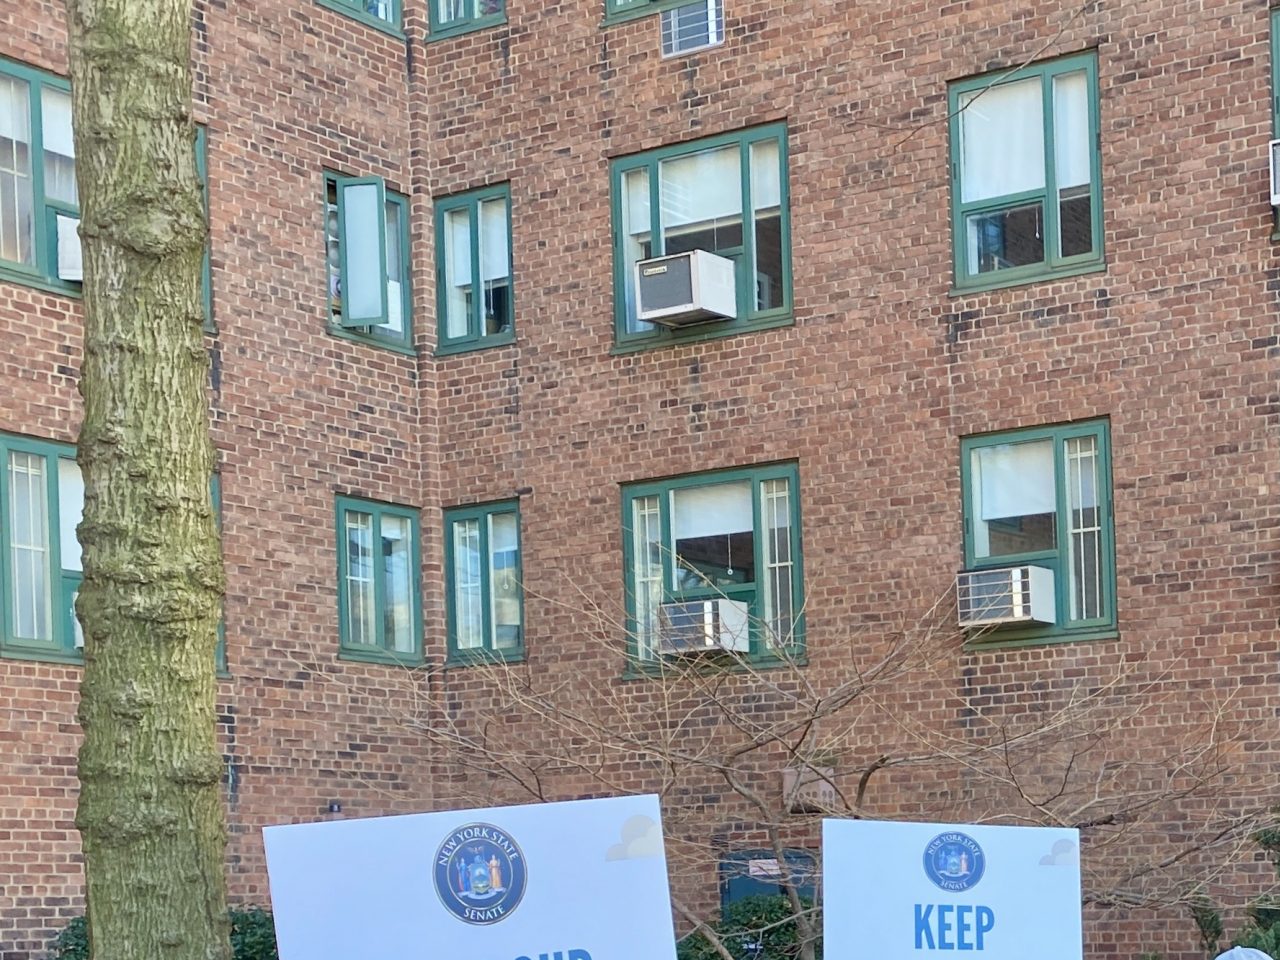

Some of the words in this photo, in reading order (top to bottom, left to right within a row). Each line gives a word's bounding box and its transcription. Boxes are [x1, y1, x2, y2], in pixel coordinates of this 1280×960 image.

[438, 837, 458, 866] NEW
[456, 827, 490, 842] YORK
[491, 831, 520, 861] STATE
[463, 904, 506, 921] SENATE
[914, 904, 995, 951] KEEP
